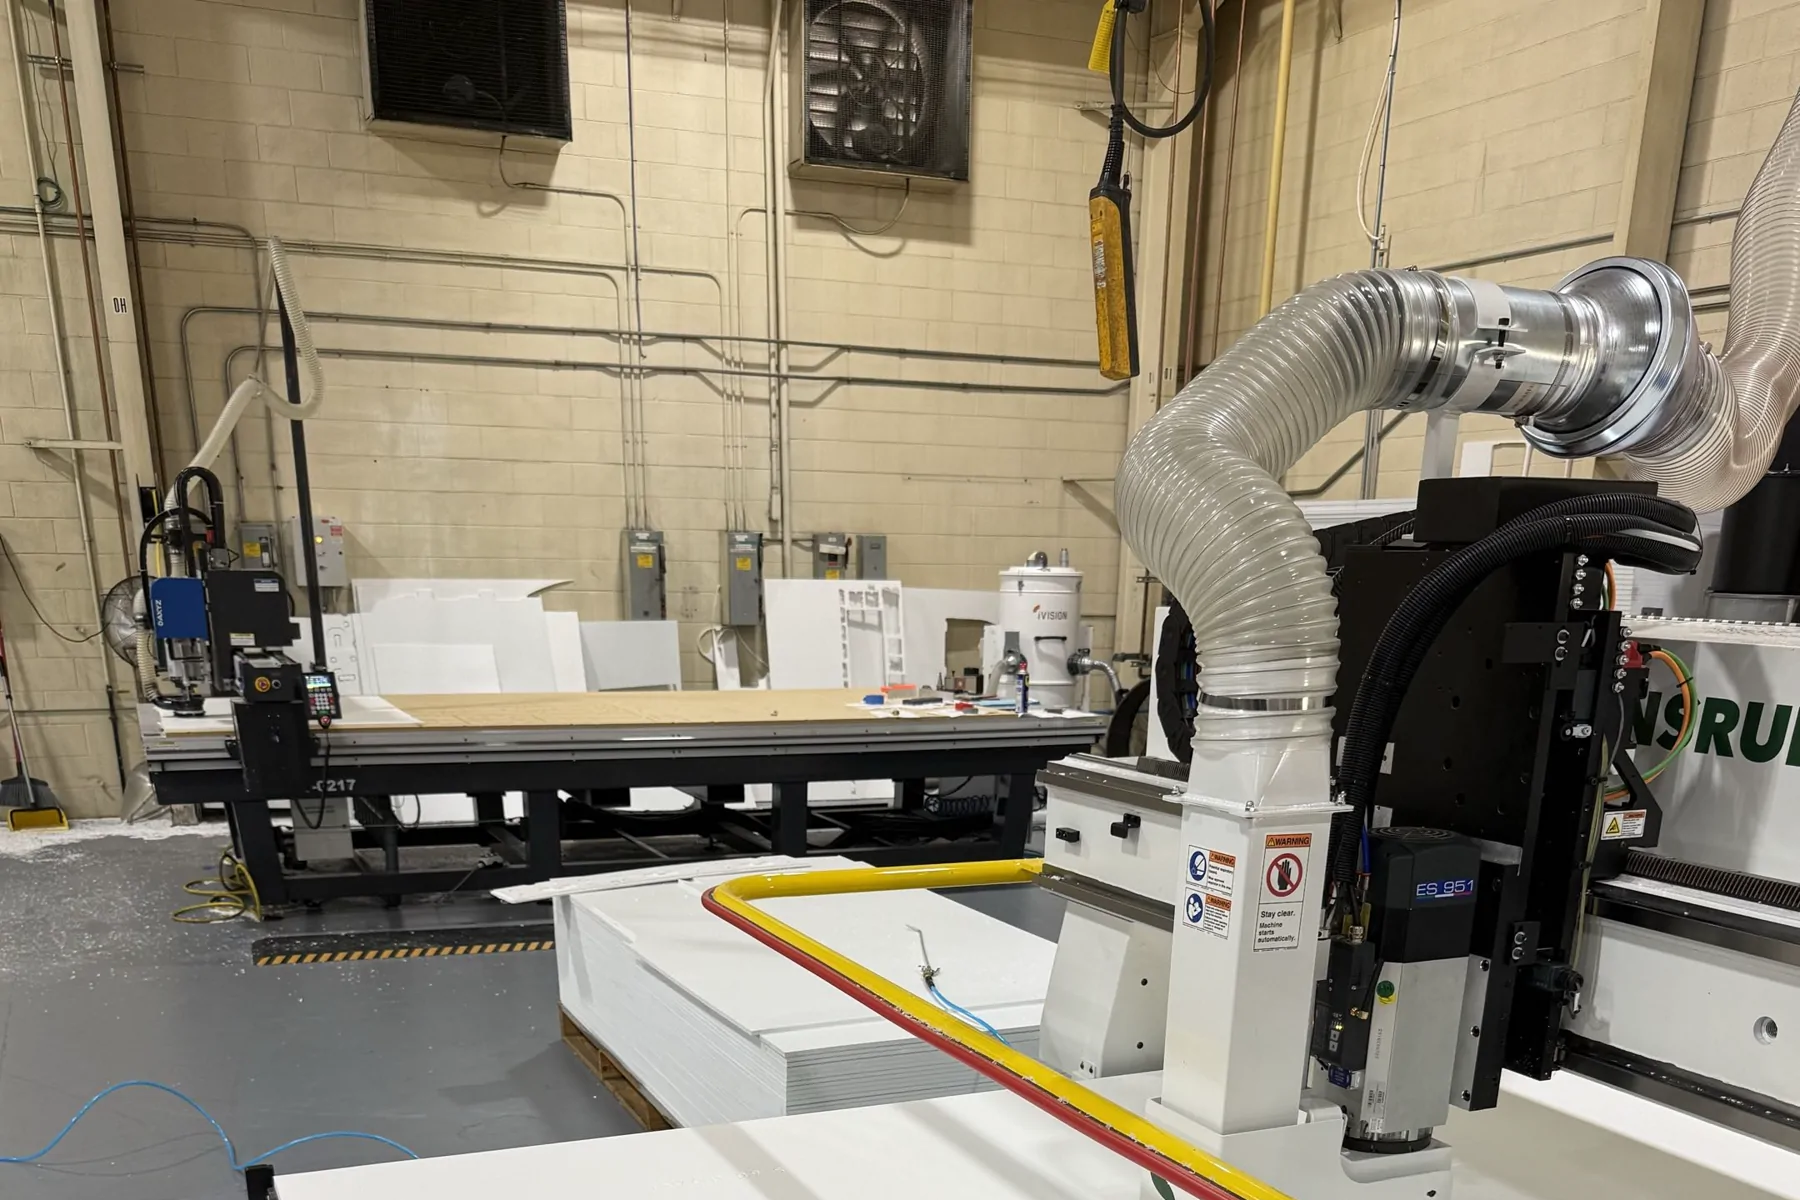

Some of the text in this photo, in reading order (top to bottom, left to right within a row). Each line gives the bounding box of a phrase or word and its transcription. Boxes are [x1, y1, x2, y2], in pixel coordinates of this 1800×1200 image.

[1275, 837, 1310, 846] WARNING
[1416, 880, 1474, 896] ES 951
[1261, 911, 1276, 919] Stay
